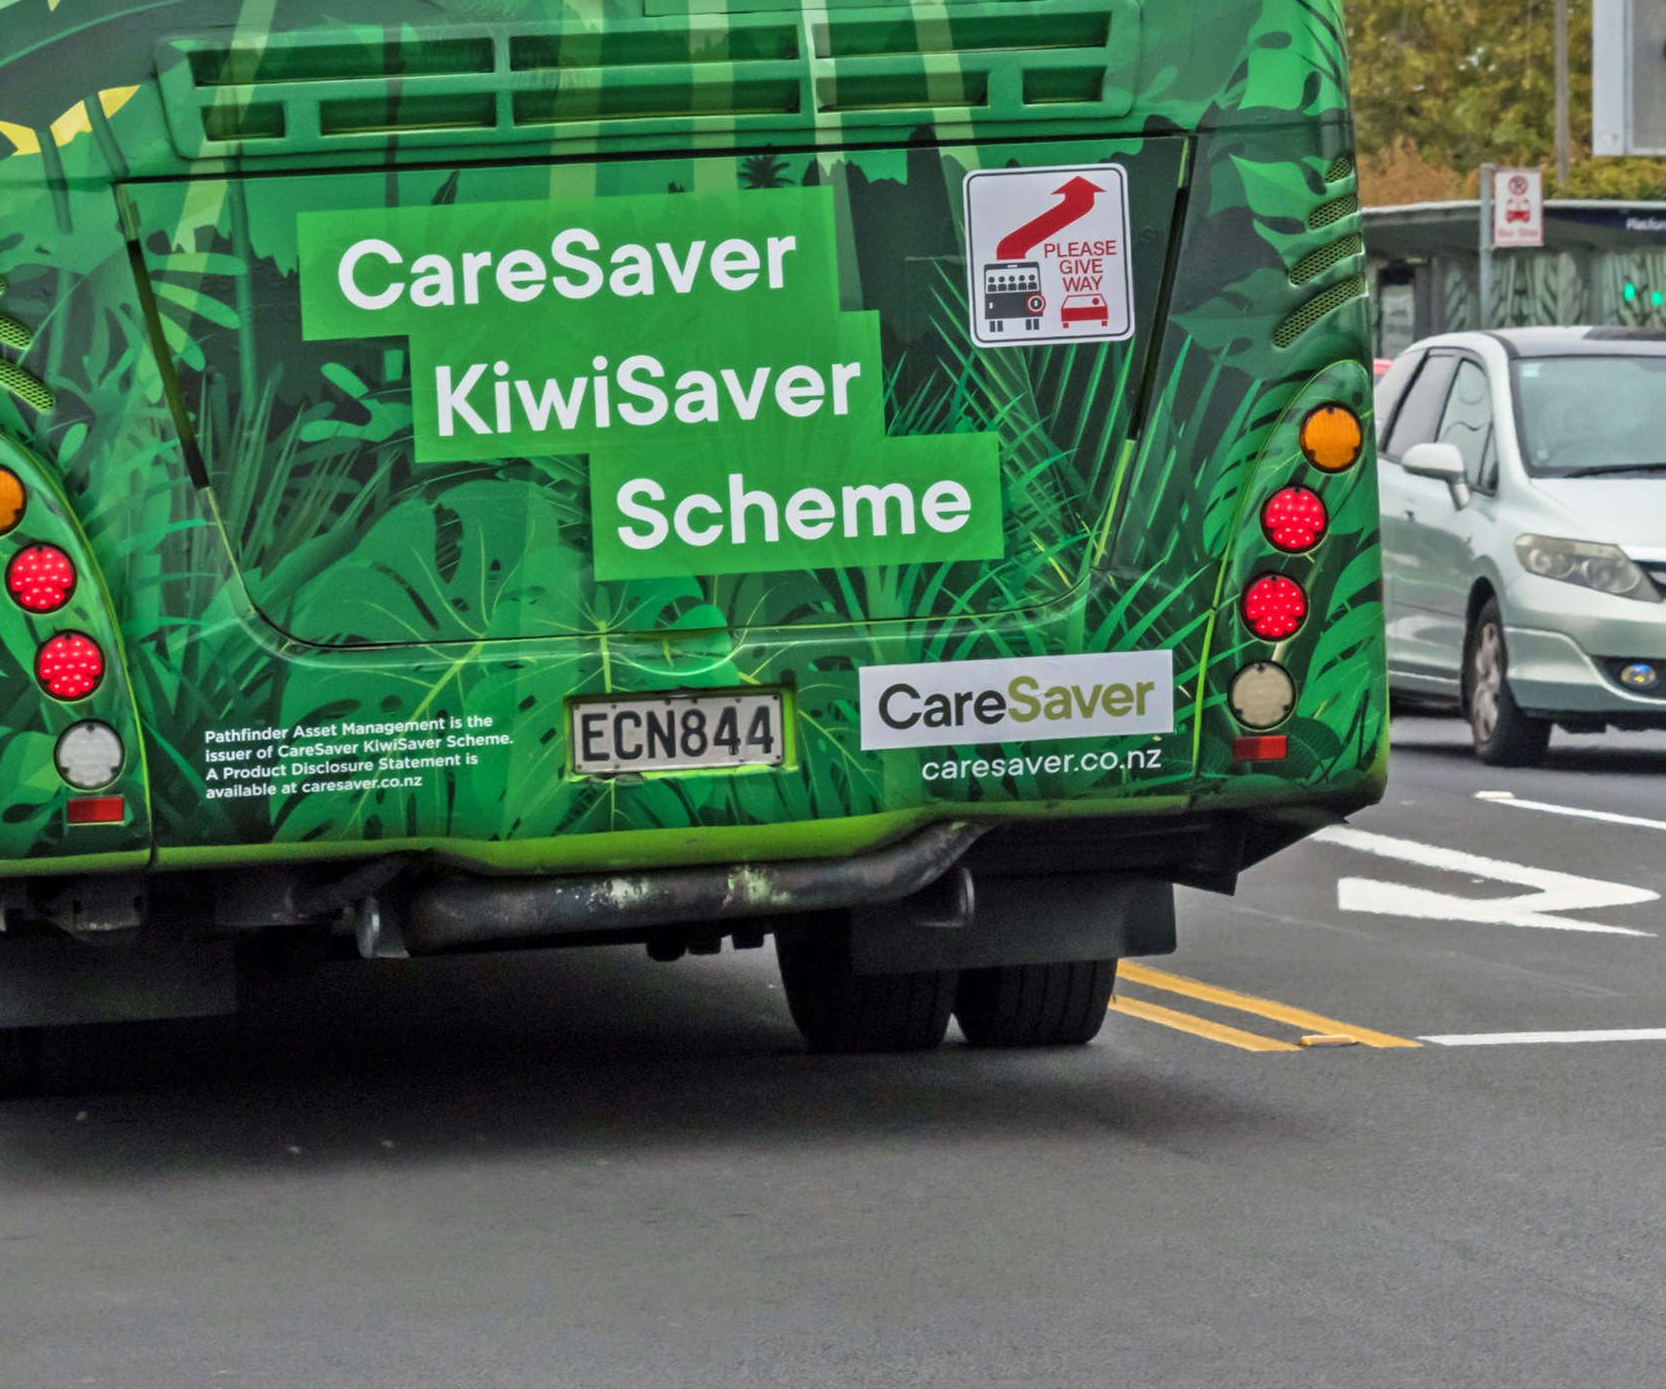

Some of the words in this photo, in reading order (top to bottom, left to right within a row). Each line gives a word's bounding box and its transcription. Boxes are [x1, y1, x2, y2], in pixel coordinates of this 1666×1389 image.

[1044, 240, 1117, 259] PLEASE
[337, 228, 797, 310] CareSaver
[1059, 258, 1104, 276] GIVE
[1062, 275, 1104, 294] WAY
[435, 355, 861, 437] KiwiSaver
[616, 474, 972, 550] Scheme
[878, 675, 1155, 732] CareSaver
[205, 726, 288, 744] Pathfinder
[293, 724, 337, 738] Asset
[342, 717, 445, 739] Management
[450, 716, 462, 729] is
[467, 714, 493, 728] the
[581, 705, 775, 762] ECN844
[205, 748, 251, 762] issuer
[256, 745, 273, 759] of
[278, 742, 358, 758] CareSaver
[363, 737, 441, 753] KiwiSaver
[446, 732, 514, 747] Scheme.
[206, 768, 218, 781] A
[223, 765, 287, 780] Product
[292, 760, 374, 776] Disclosure
[379, 756, 461, 771] Statement
[466, 753, 478, 766] is
[921, 747, 1162, 782] caresaver.co.nz
[206, 784, 277, 799] available
[281, 784, 298, 795] at
[302, 776, 423, 793] caresaver.co.nz
